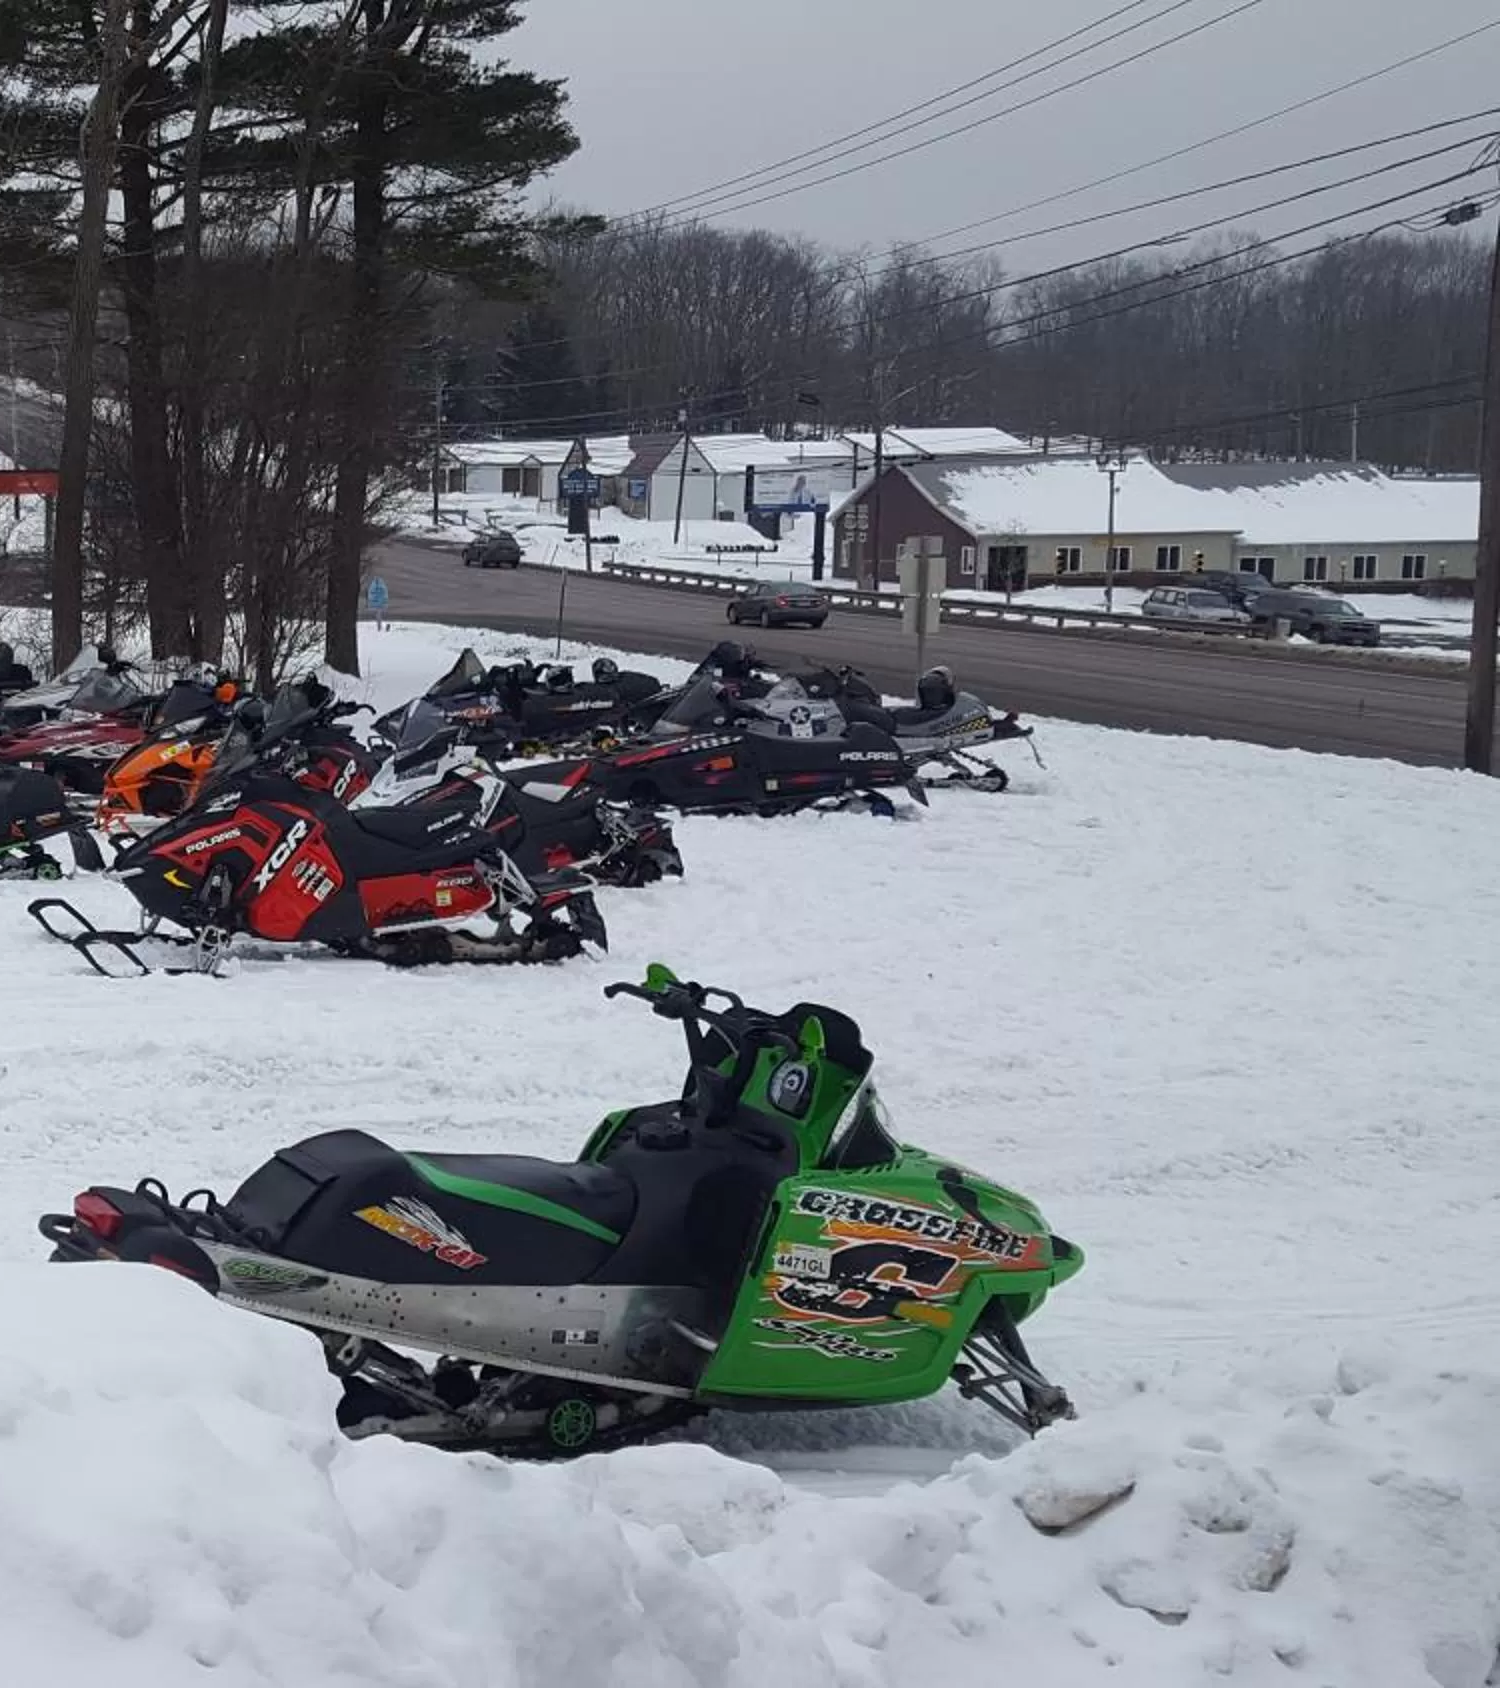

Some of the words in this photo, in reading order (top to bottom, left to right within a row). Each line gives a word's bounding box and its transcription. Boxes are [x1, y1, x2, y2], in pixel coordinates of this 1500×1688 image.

[839, 751, 898, 761] POLARIS
[185, 828, 242, 855] POLARIS
[253, 820, 308, 895] XCR
[799, 1188, 1028, 1261] CROSSFIRE
[776, 1254, 827, 1273] 4471GL
